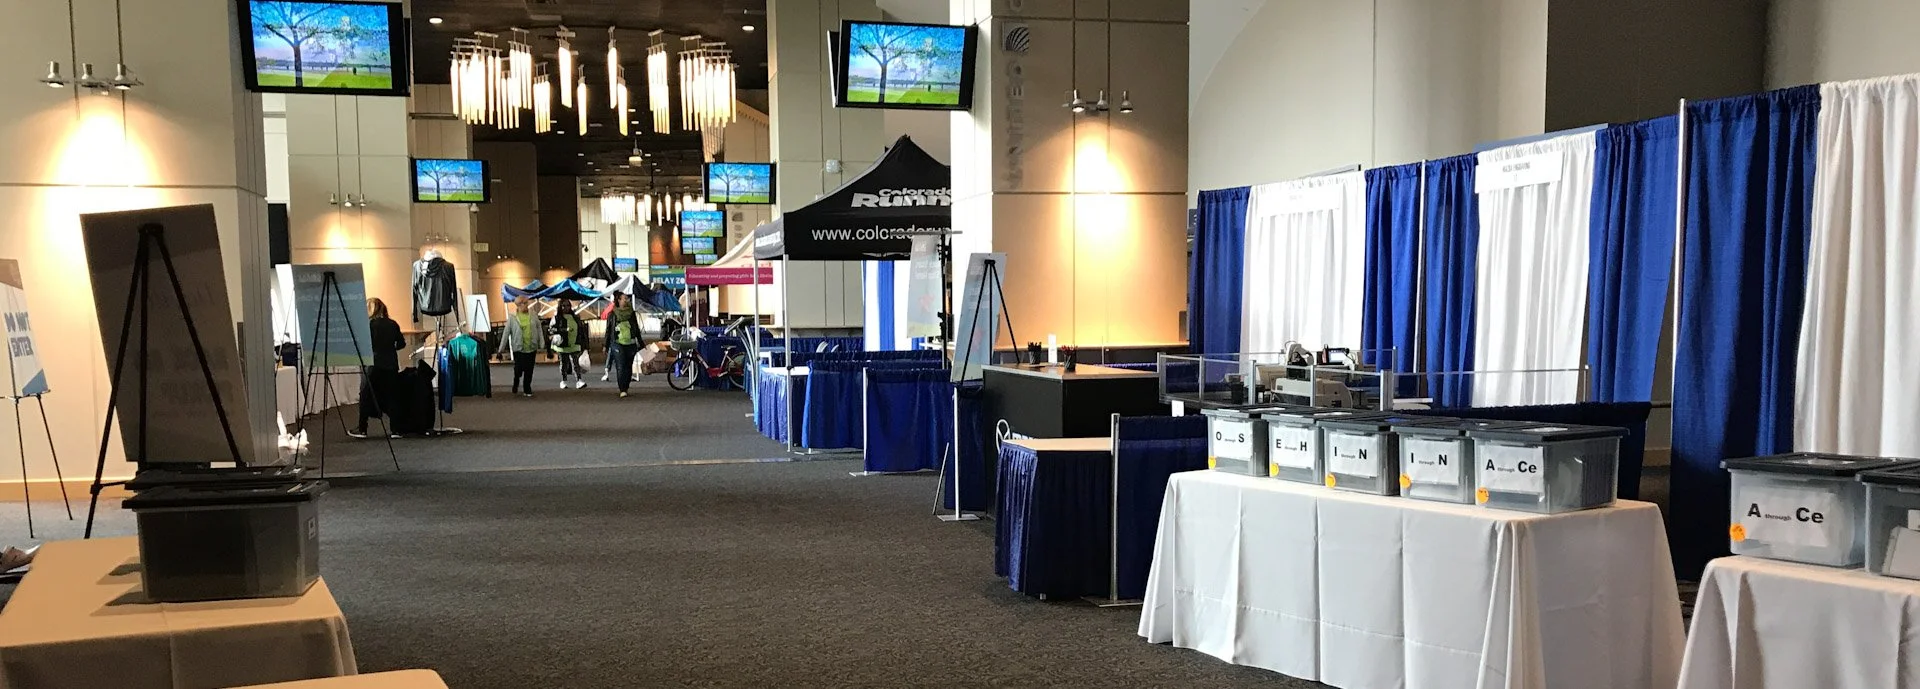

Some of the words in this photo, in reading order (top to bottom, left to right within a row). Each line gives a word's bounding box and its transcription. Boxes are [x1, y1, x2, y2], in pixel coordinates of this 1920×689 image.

[652, 276, 675, 285] RELAY
[4, 312, 15, 332] DO
[15, 312, 31, 332] NOT
[10, 336, 34, 357] ENTER
[1215, 431, 1222, 441] O
[1238, 433, 1245, 443] S
[1276, 439, 1282, 449] E
[1300, 441, 1307, 451] H
[1334, 446, 1338, 457] I
[1359, 449, 1367, 460] N
[1410, 452, 1414, 464] I
[1438, 454, 1447, 466] N
[1485, 459, 1495, 471] A
[1517, 460, 1537, 474] Ce
[1747, 503, 1761, 518] A
[1764, 513, 1791, 521] through
[1795, 507, 1824, 523] Ce
